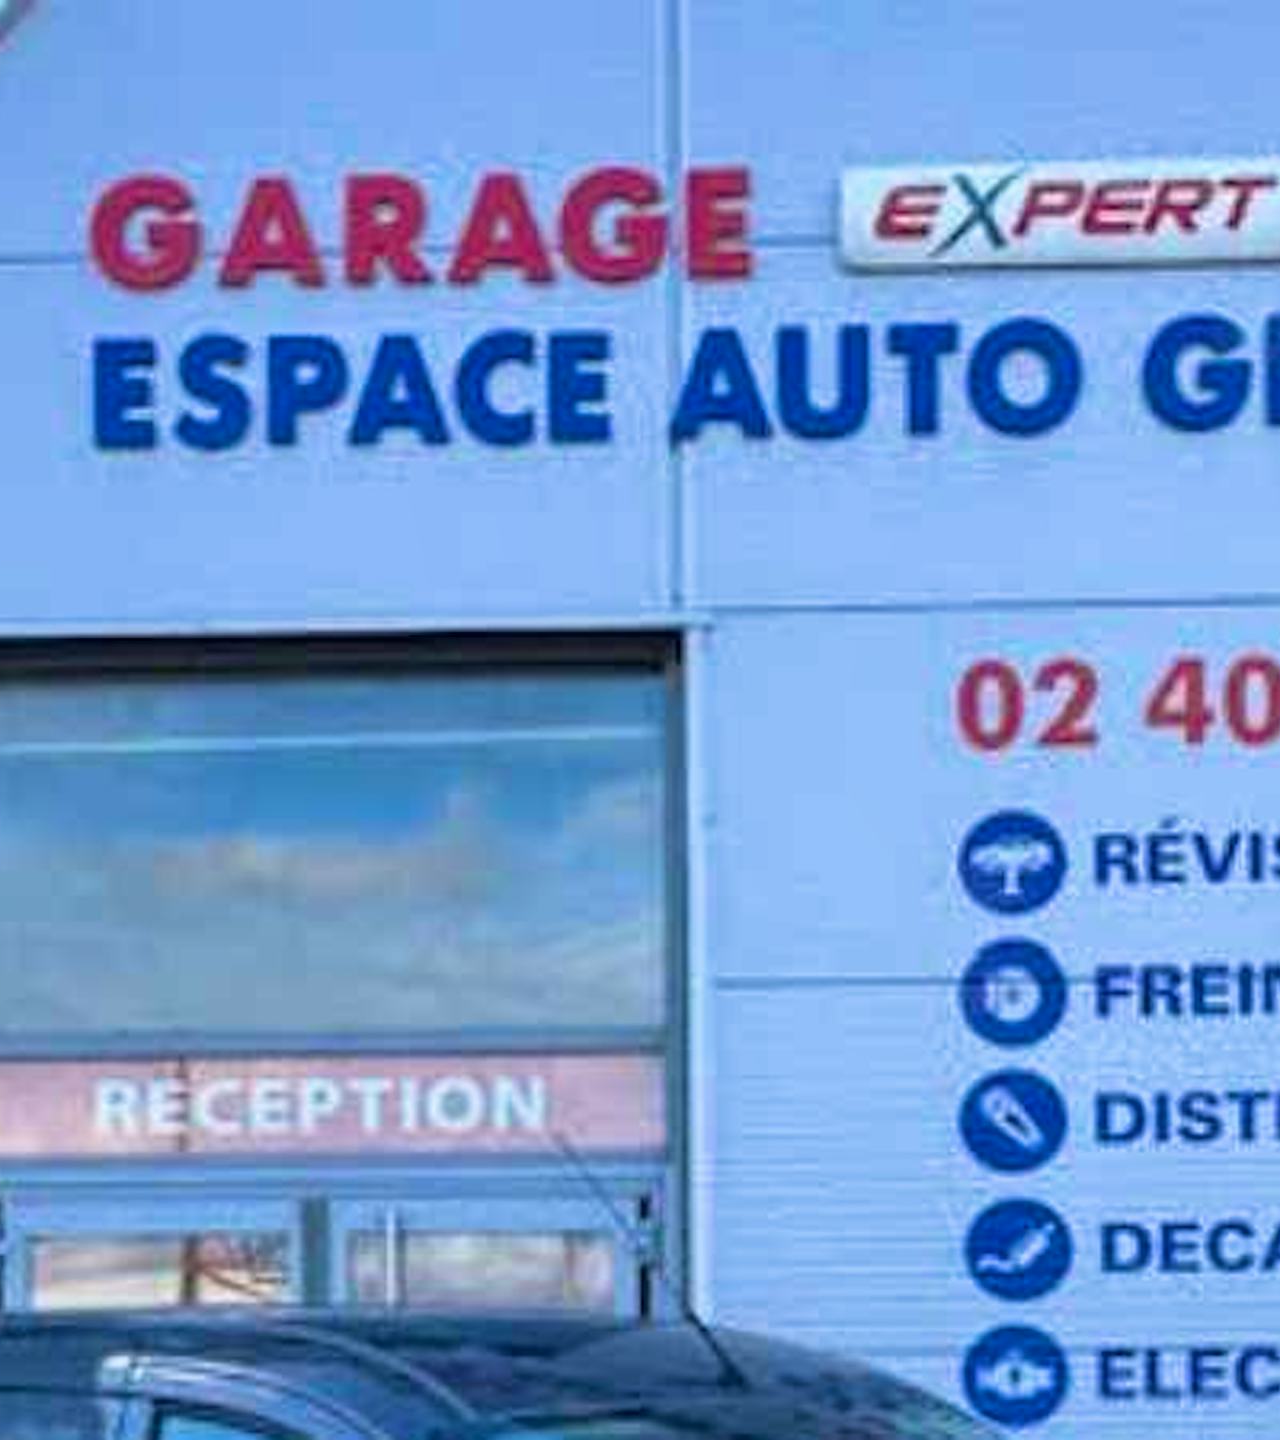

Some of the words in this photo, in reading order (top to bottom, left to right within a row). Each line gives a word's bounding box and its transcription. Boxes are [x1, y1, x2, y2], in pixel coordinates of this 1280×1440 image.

[90, 166, 753, 292] GARAGE
[93, 329, 612, 452] ESPACE
[670, 317, 1083, 450] AUTO
[956, 657, 1097, 752] 02
[93, 1076, 546, 1136] RECEPTION
